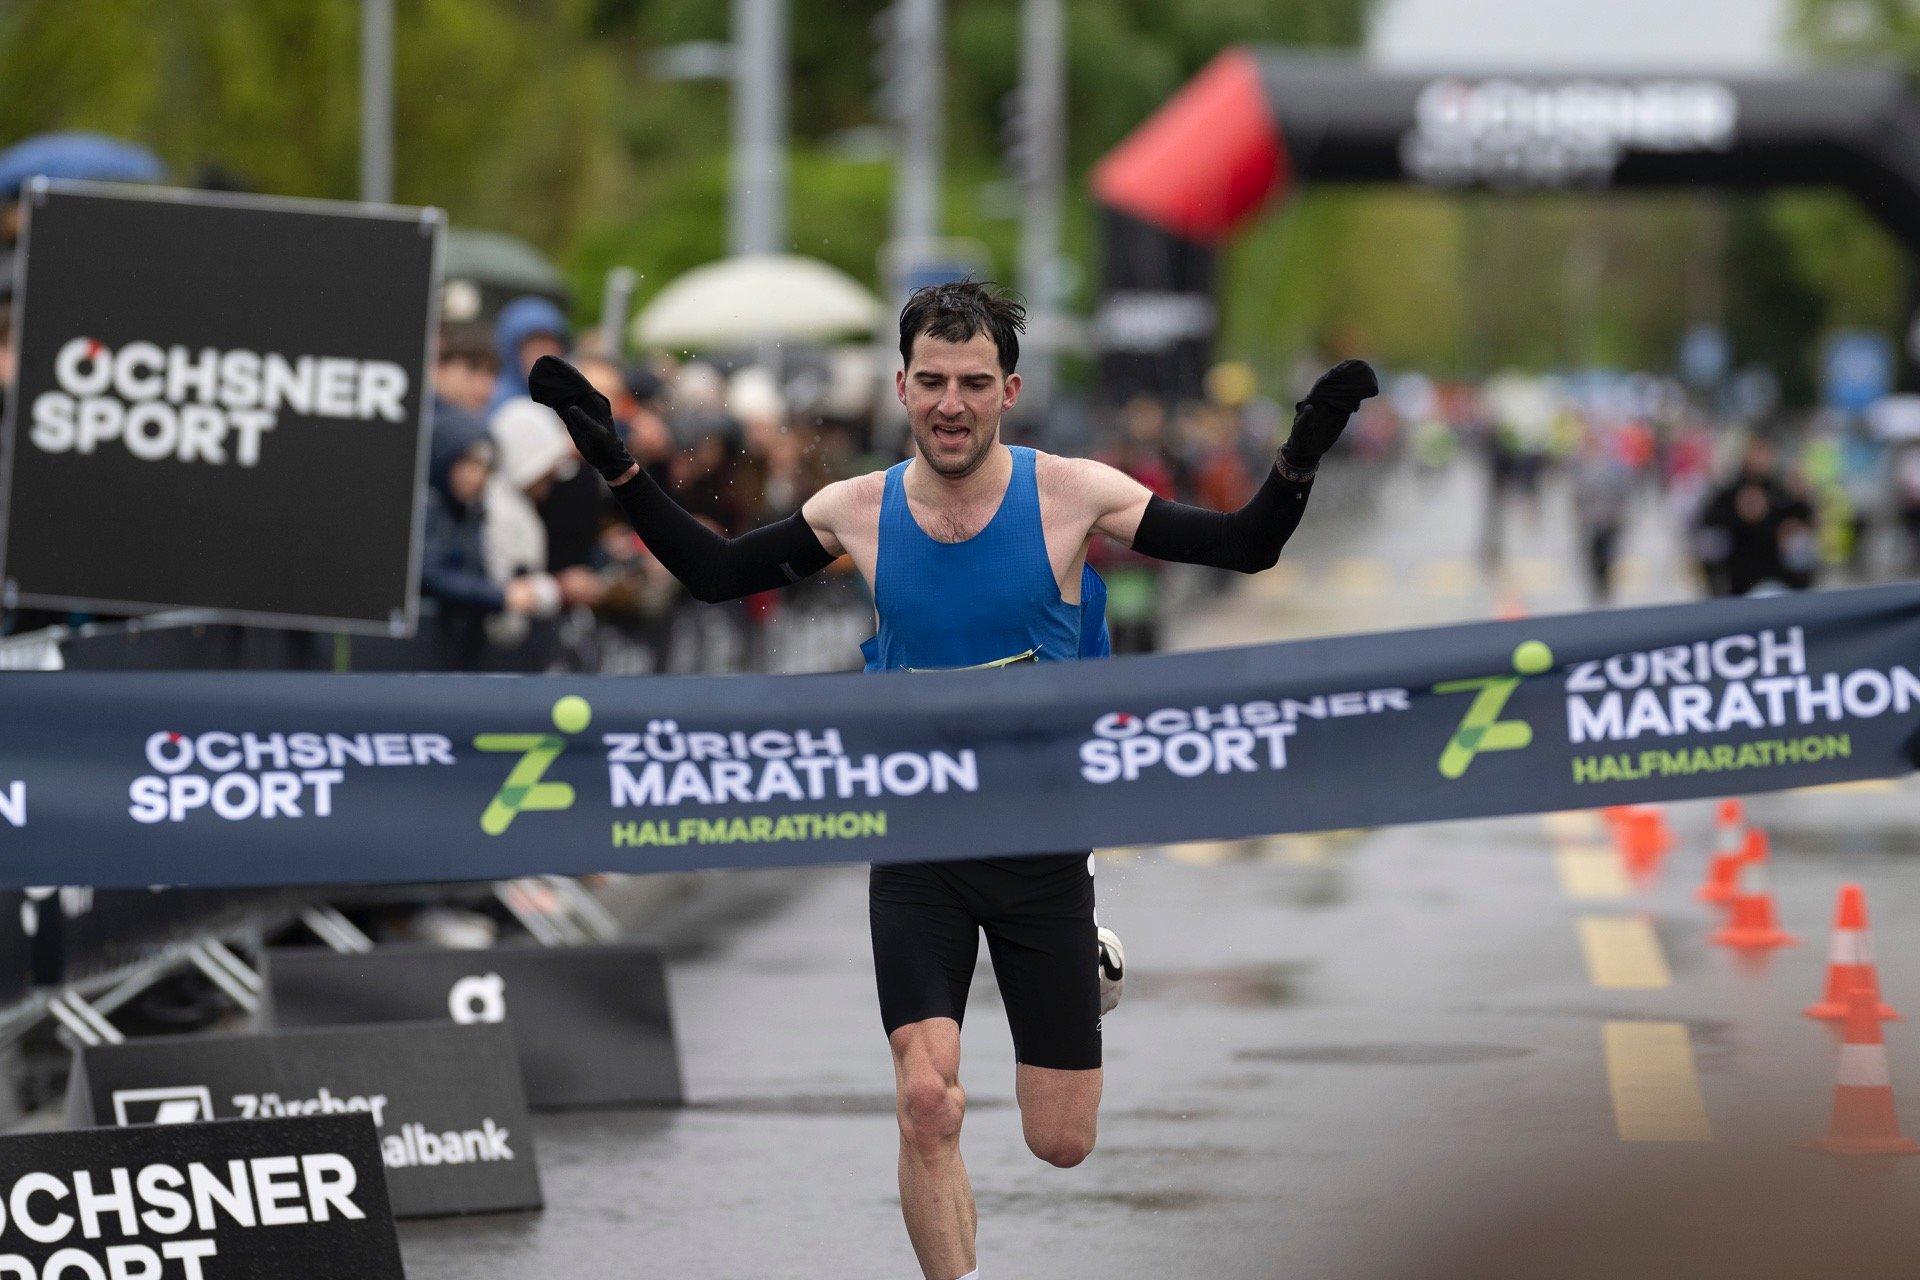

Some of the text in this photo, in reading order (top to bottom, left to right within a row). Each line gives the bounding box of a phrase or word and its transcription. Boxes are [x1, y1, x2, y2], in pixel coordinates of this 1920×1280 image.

[55, 337, 408, 422] OCHSNER
[31, 391, 277, 467] SPORT
[1092, 688, 1411, 739] OCHSNER
[1567, 665, 1920, 743] MARATHON
[145, 731, 457, 774] OCHSNER
[602, 720, 844, 763] ZÜRICH
[1079, 722, 1297, 784] SPORT
[1572, 732, 1852, 784] HALFMARATHON
[128, 769, 344, 824] SPORT
[608, 749, 979, 808] MARATHON
[612, 811, 888, 848] HALFMARATHON
[382, 1117, 514, 1168] albank
[0, 1153, 366, 1243] CHSNER
